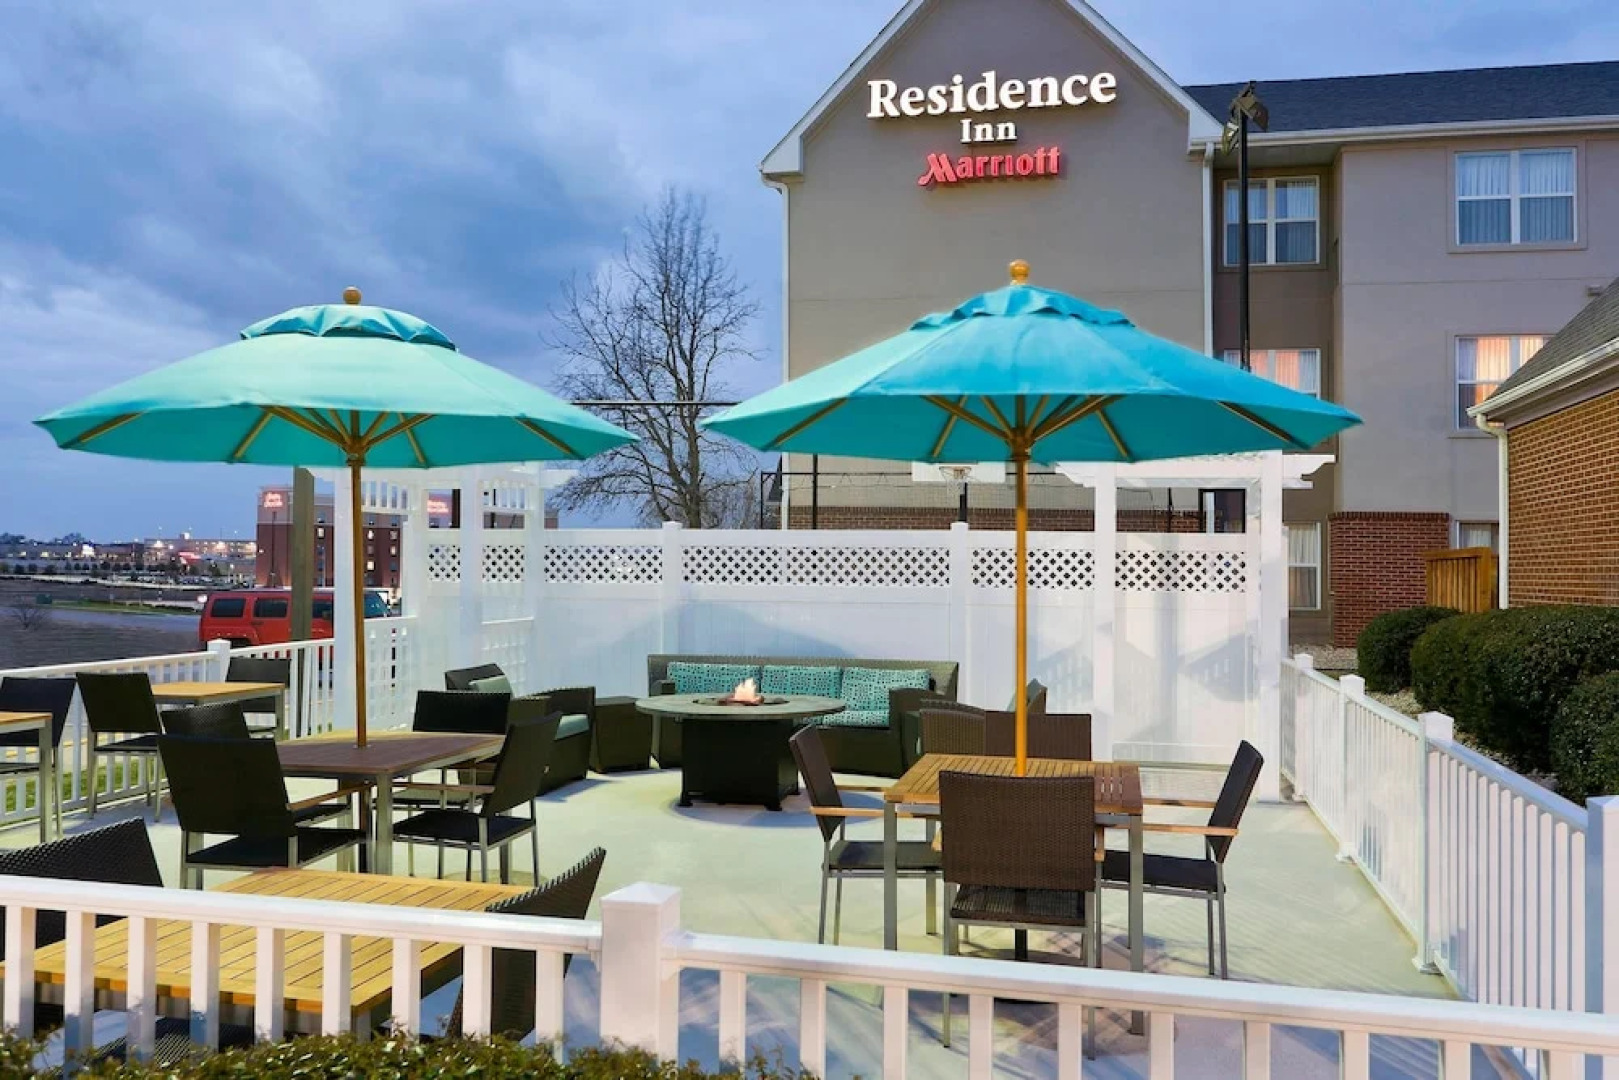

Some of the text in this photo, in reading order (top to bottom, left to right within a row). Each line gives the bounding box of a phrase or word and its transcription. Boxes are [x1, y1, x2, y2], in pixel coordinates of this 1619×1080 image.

[866, 70, 1117, 119] Residence
[960, 118, 1018, 143] Inn
[918, 146, 1061, 186] Marriott
